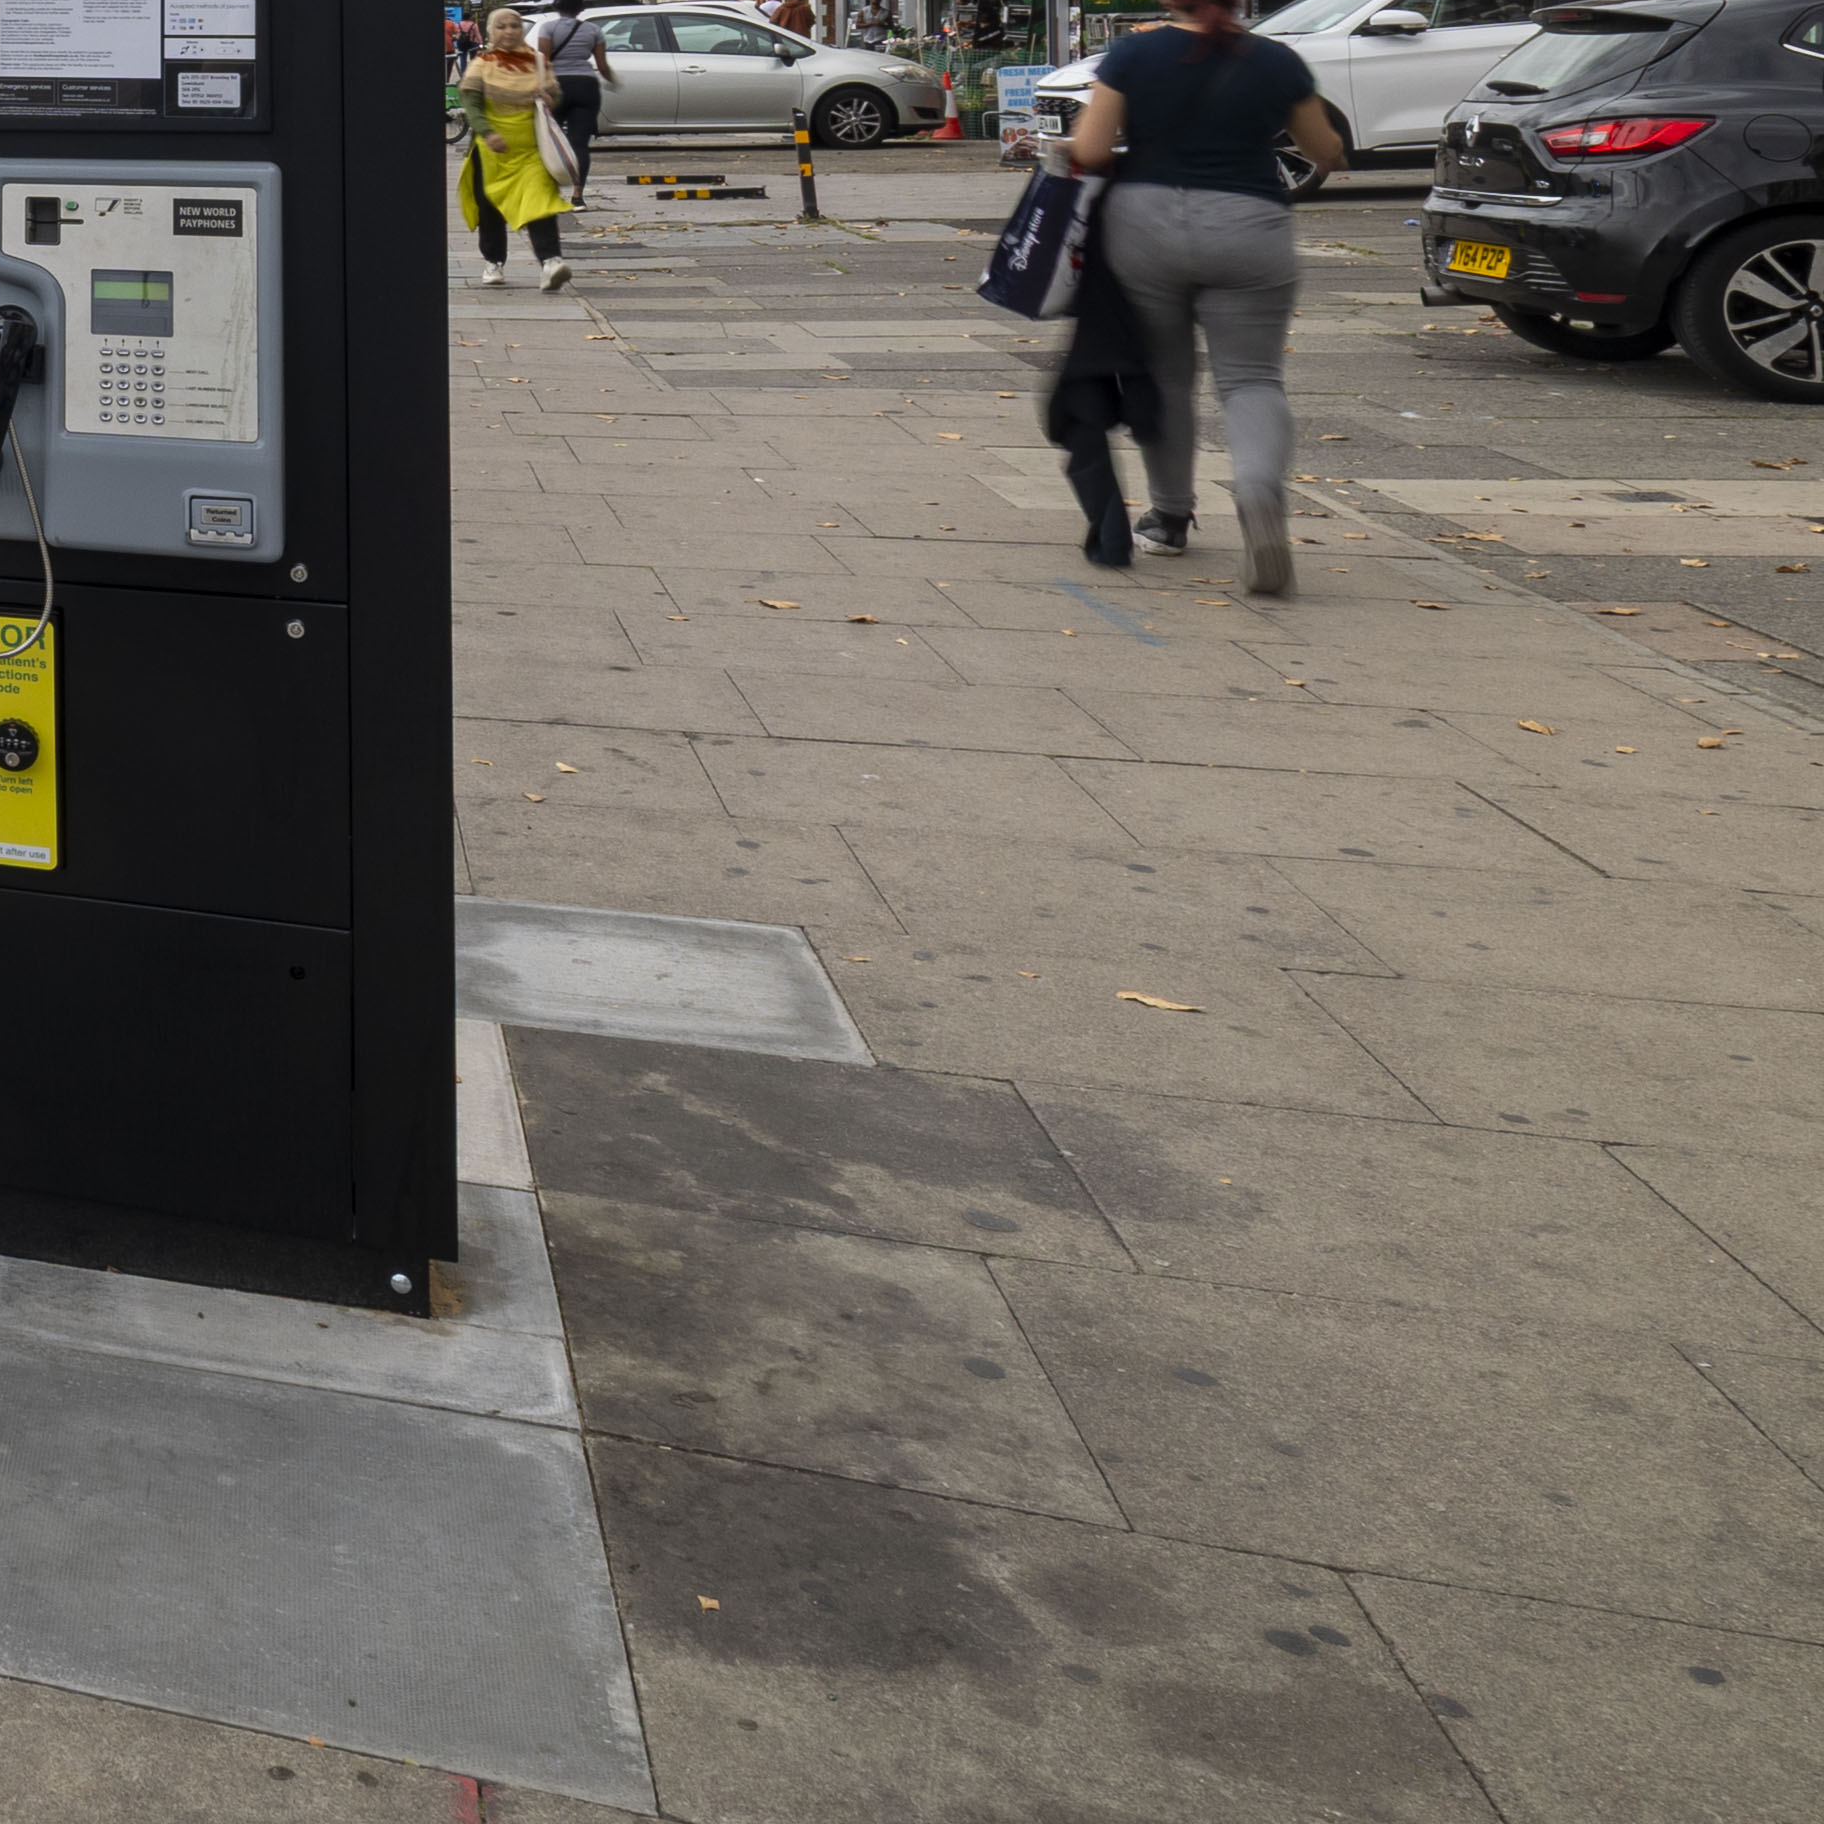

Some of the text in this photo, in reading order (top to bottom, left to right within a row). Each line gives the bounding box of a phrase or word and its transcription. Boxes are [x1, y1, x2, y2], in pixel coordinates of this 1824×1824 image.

[999, 68, 1026, 77] FRESH
[0, 83, 29, 91] Emergency
[1005, 88, 1032, 97] FRESH
[179, 206, 236, 217] NEW WORLD
[180, 219, 236, 229] PAYPHONES
[1008, 231, 1041, 271] Disney
[1452, 243, 1505, 271] AY64 PZP
[206, 508, 237, 516] Returned
[18, 776, 34, 787] left
[9, 786, 33, 795] open
[5, 845, 27, 858] after
[28, 849, 46, 860] use
